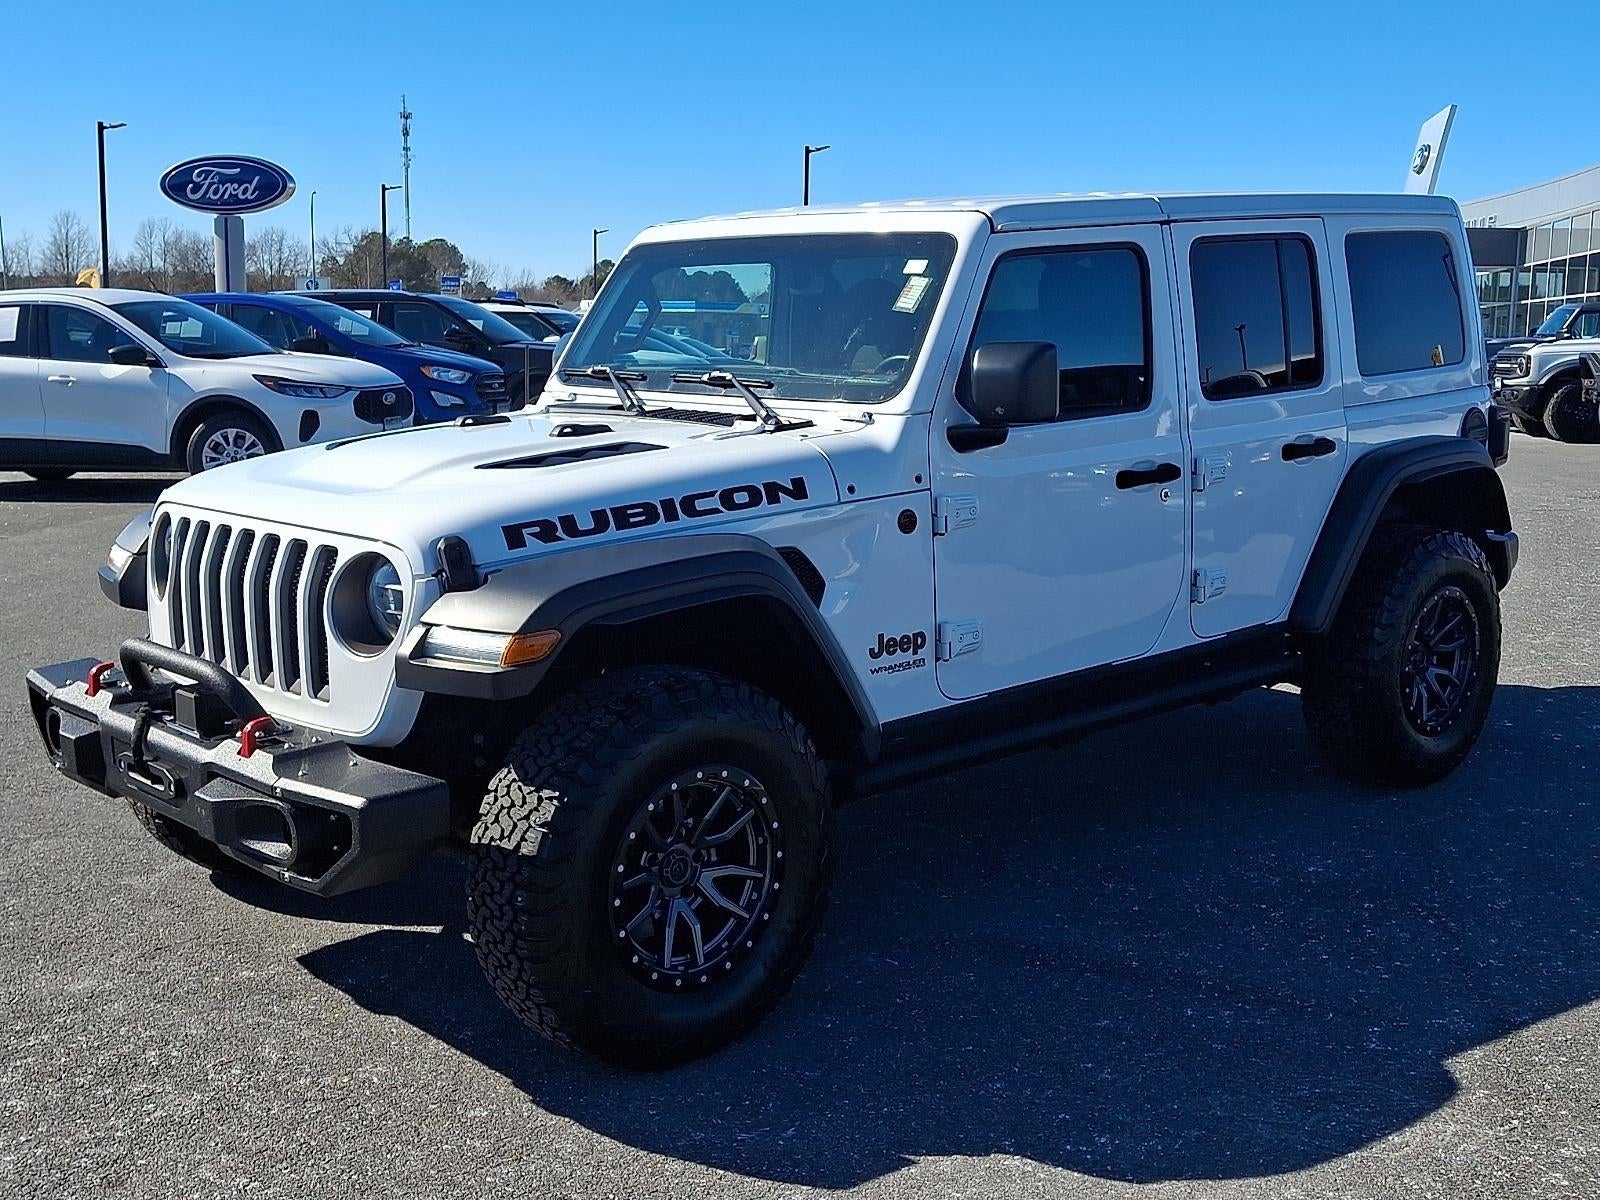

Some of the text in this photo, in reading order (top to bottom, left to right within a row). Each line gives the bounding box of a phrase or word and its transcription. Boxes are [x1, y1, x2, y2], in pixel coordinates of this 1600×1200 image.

[187, 167, 259, 200] Ford
[501, 476, 809, 551] RUBICON
[869, 631, 926, 659] Jeep
[870, 658, 926, 675] WRANGLER
